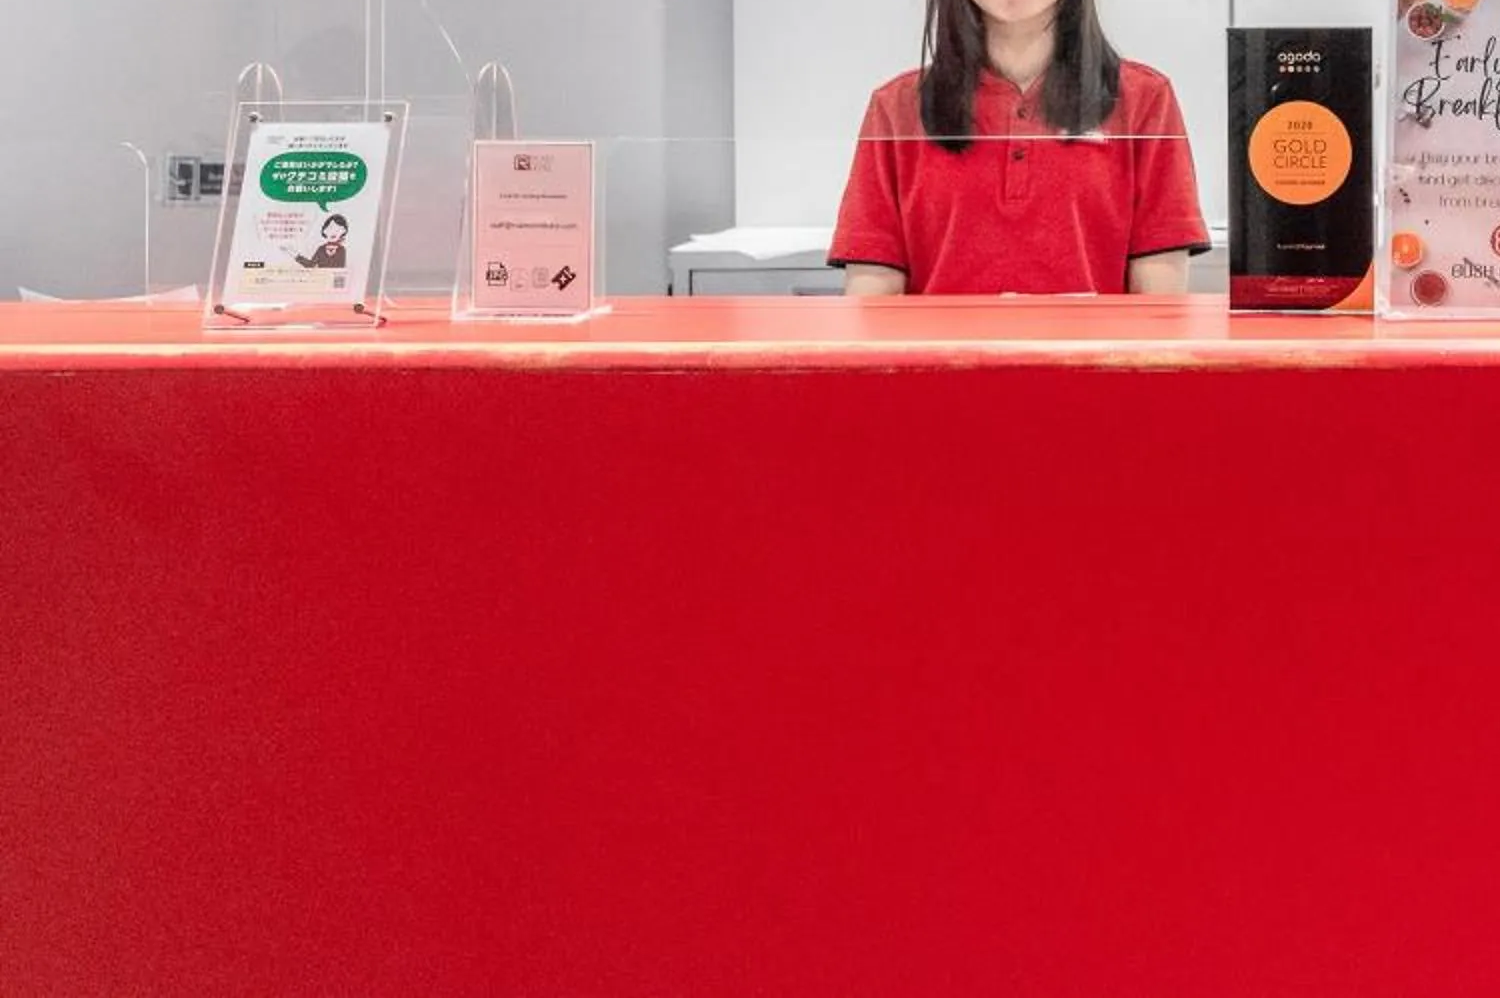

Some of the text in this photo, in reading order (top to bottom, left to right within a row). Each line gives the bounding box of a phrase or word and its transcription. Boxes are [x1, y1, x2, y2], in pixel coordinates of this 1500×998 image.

[1277, 52, 1321, 64] agoda
[1273, 139, 1327, 154] GOLD
[1273, 155, 1328, 169] CIRCLE
